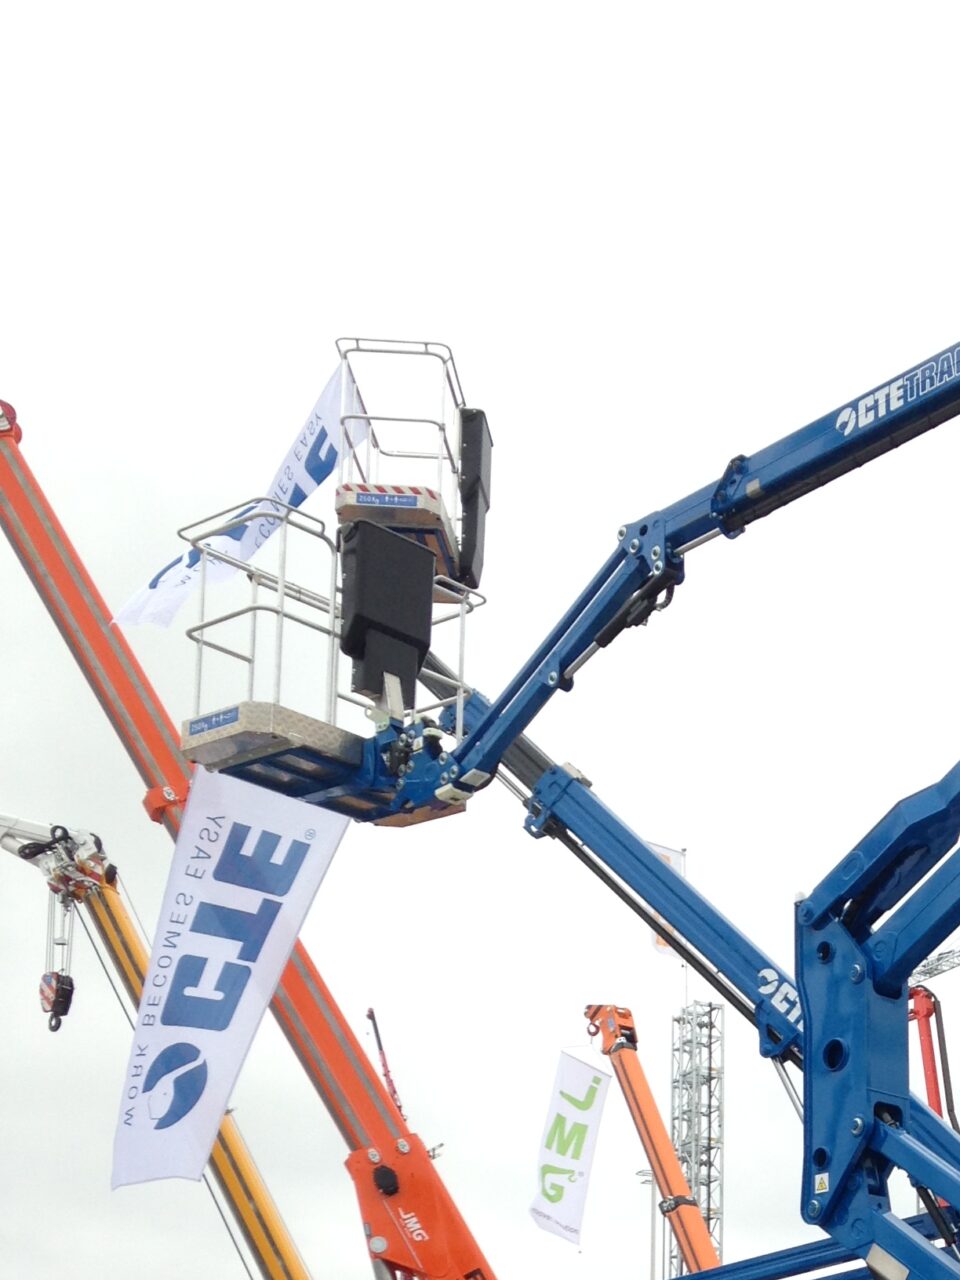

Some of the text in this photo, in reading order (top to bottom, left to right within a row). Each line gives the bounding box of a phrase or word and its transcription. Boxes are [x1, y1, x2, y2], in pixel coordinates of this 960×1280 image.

[858, 377, 905, 429] CTE
[770, 982, 804, 1033] CT
[398, 1207, 430, 1242] JMG
